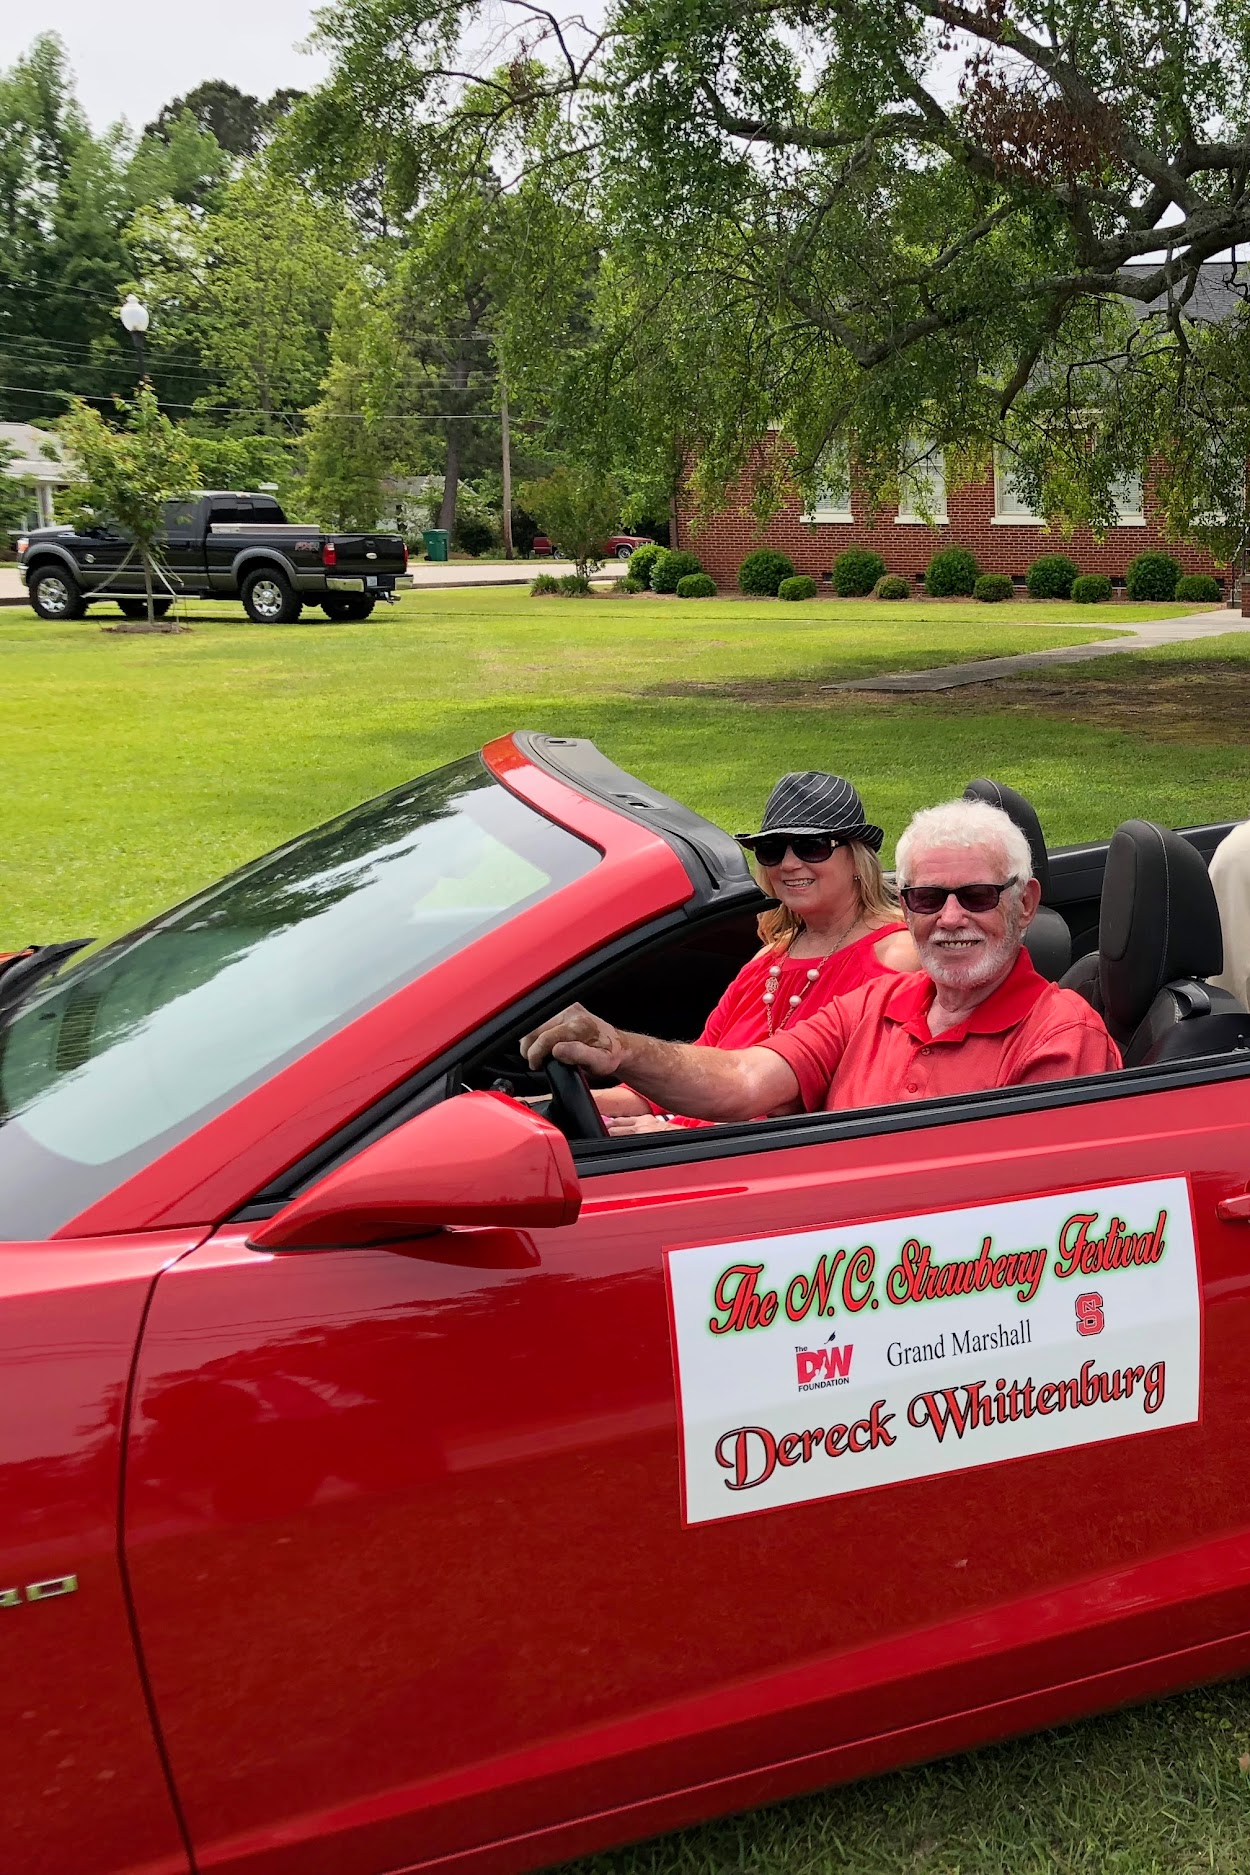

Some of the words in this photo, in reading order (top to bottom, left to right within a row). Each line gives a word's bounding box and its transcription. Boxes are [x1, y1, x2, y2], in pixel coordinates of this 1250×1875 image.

[709, 1264, 779, 1334] The
[886, 1238, 1047, 1302] Strawberry
[1054, 1210, 1167, 1279] Festival
[798, 1377, 850, 1392] FOUNDATION
[886, 1328, 946, 1367] Grand
[951, 1319, 1033, 1357] Marshall
[715, 1399, 897, 1491] Dereck
[907, 1359, 1167, 1443] Whittenburg
